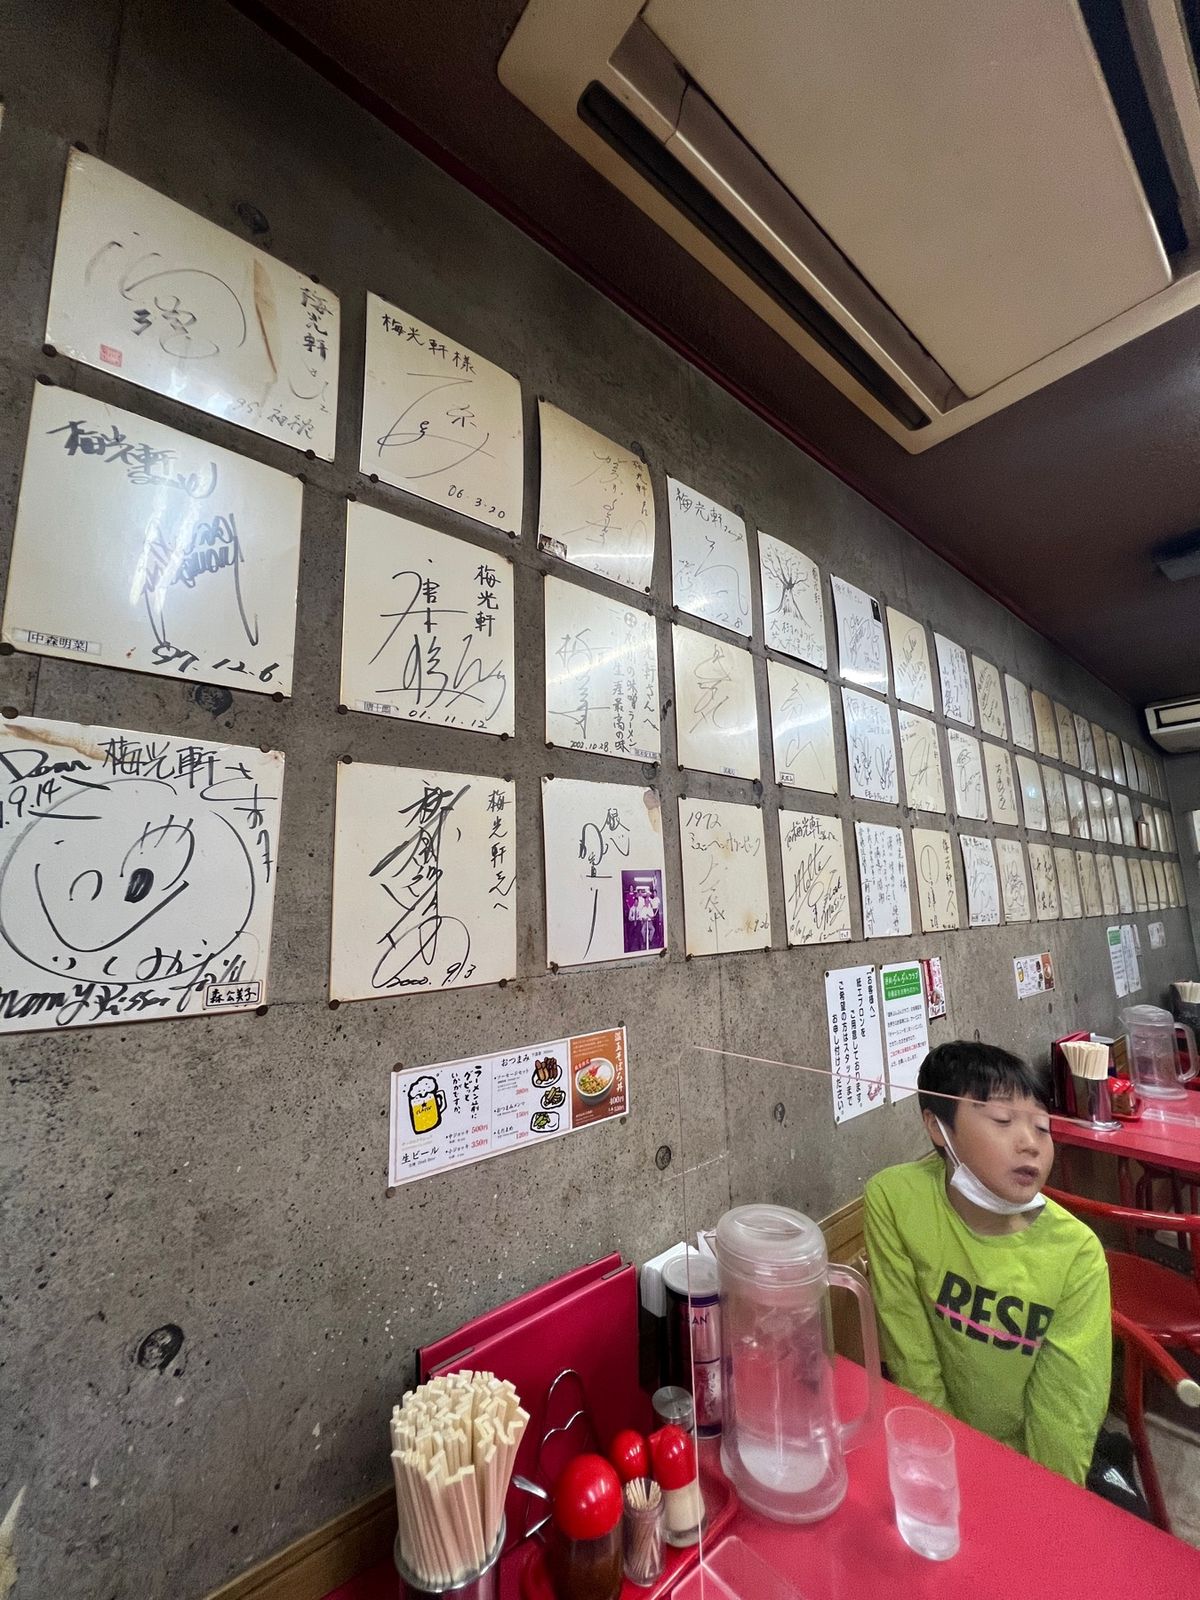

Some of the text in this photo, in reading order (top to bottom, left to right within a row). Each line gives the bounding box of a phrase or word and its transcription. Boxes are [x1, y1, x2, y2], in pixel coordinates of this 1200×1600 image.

[381, 313, 478, 376] 梅光軒様
[30, 632, 85, 651] 中森明菜
[686, 811, 721, 830] 1972
[501, 1054, 530, 1067] おつまみ
[471, 1124, 489, 1134] 500円
[471, 1138, 489, 1149] 350円
[401, 1146, 439, 1165] 生ビール
